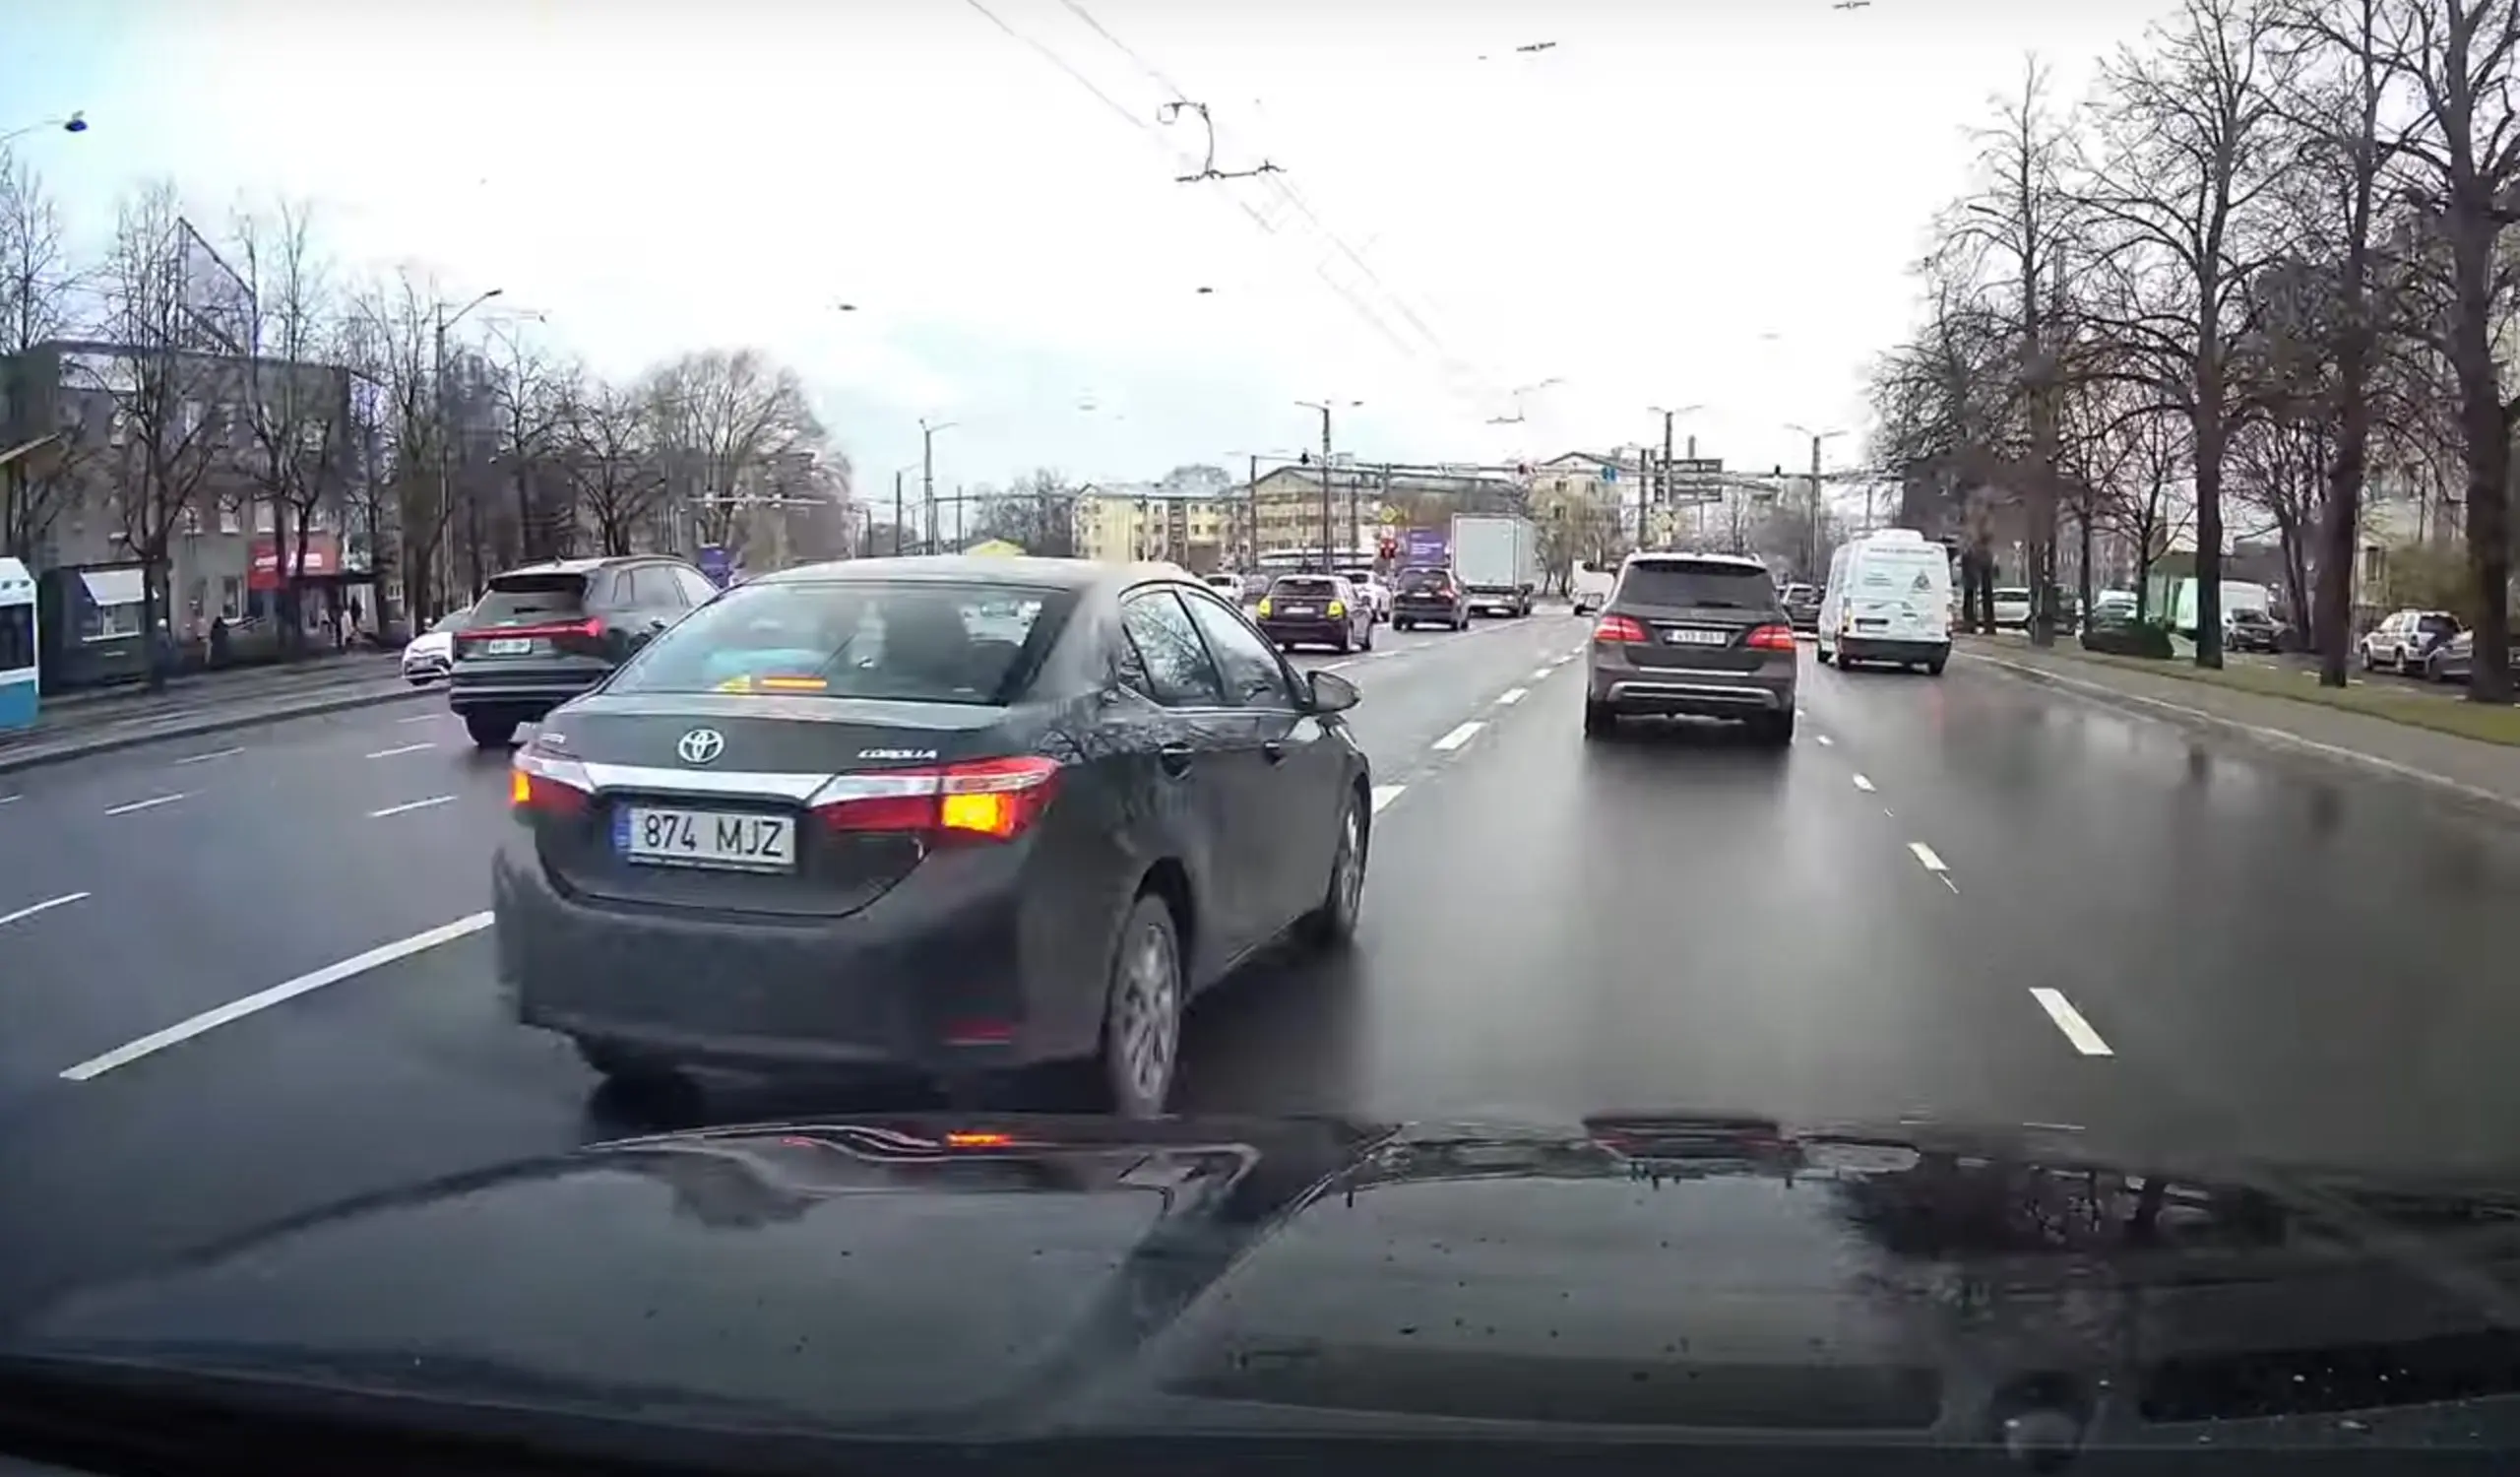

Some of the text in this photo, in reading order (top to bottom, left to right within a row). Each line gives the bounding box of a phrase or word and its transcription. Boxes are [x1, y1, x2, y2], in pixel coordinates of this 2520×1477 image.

[856, 748, 937, 759] COROLLA
[645, 813, 696, 851] 874
[717, 816, 782, 857] MJZ
